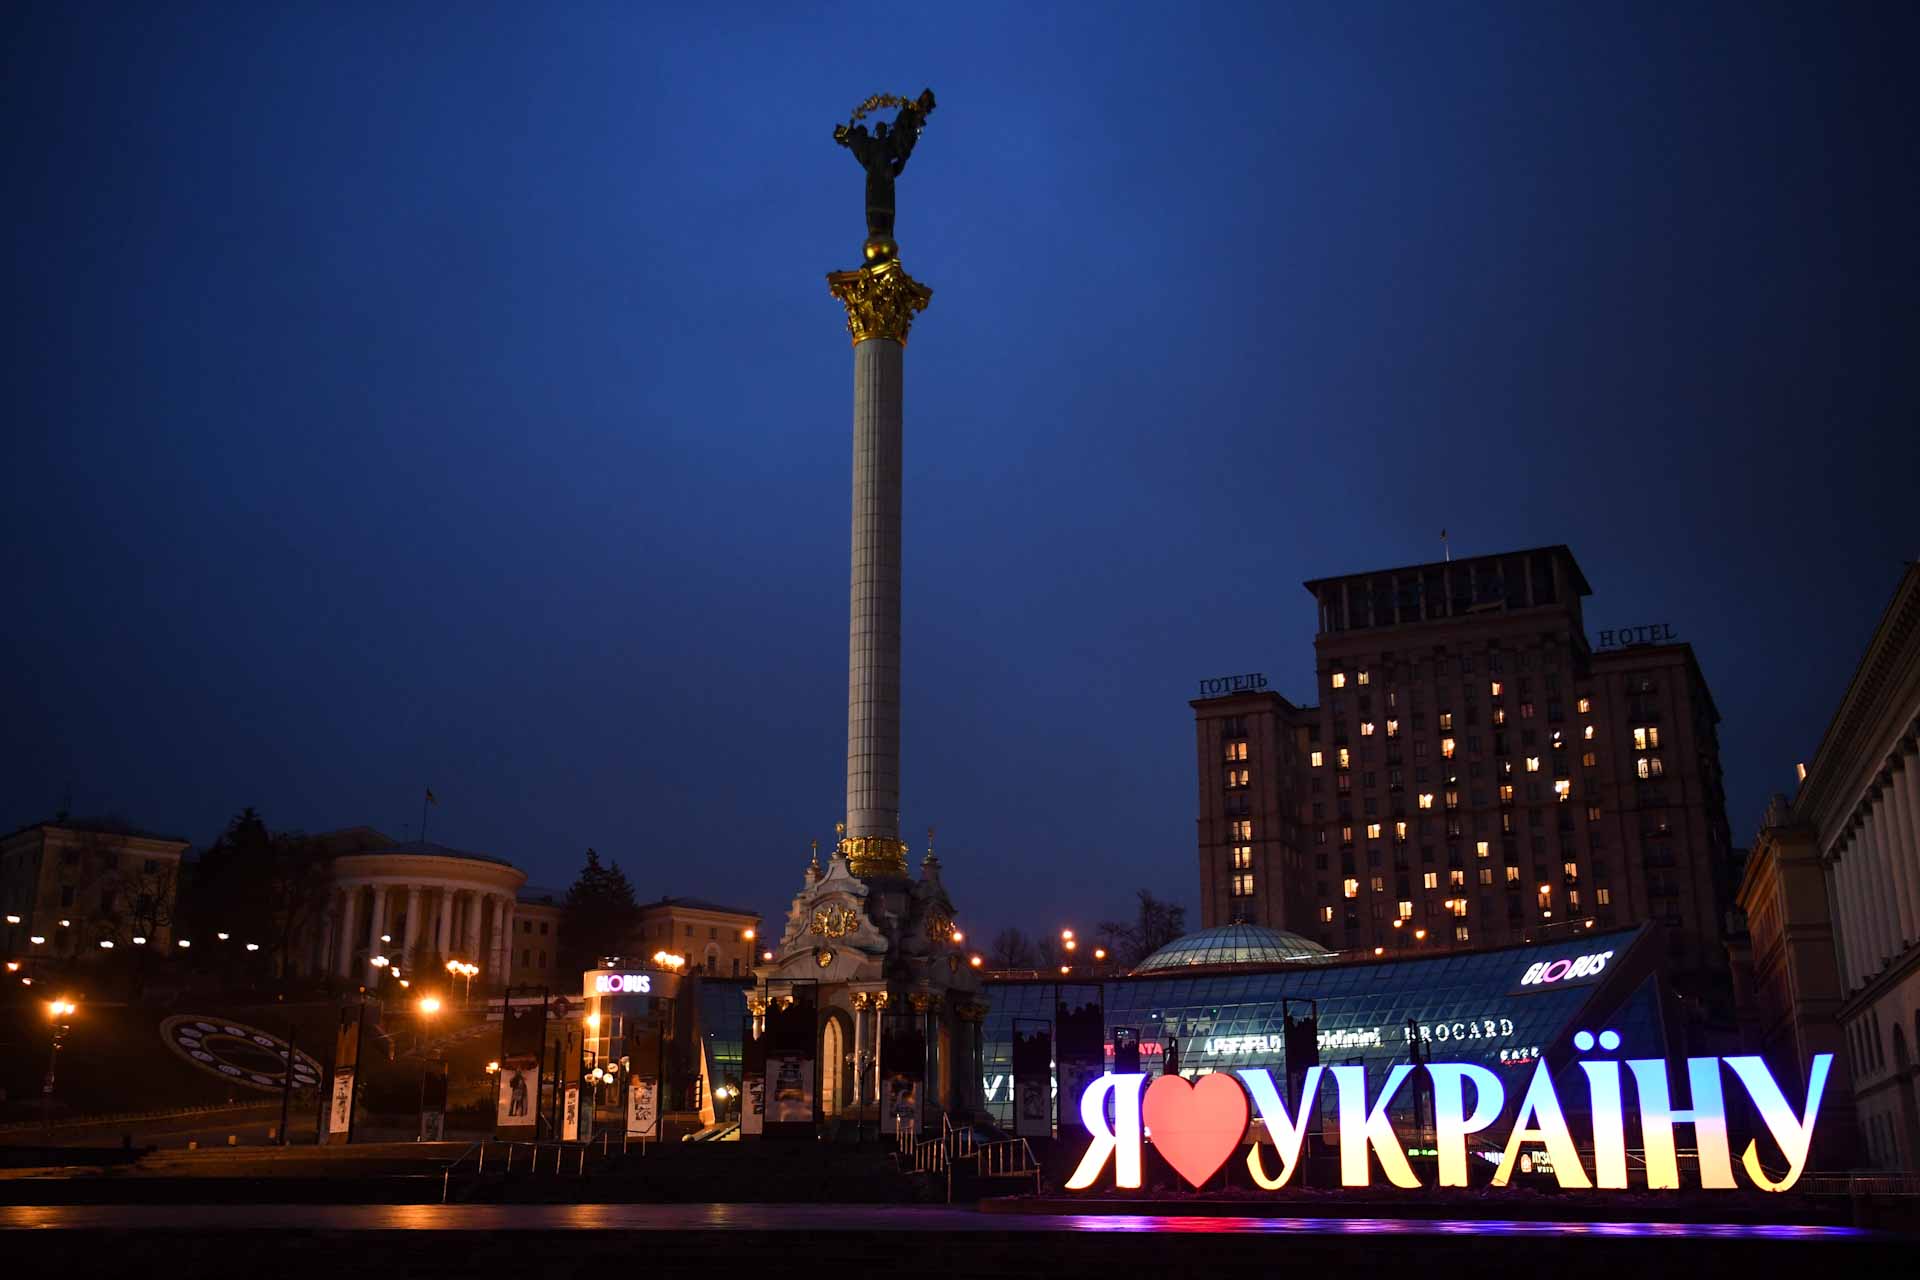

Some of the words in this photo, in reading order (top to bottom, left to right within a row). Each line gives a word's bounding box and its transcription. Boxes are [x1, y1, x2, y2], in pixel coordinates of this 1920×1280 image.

[1597, 623, 1678, 647] HOTEL
[1199, 673, 1268, 695] ГОТЕЛЬ
[1520, 950, 1614, 986] GLOBUS
[1065, 1072, 1148, 1191] Я
[1238, 1030, 1833, 1192] УКРАЇНУ
